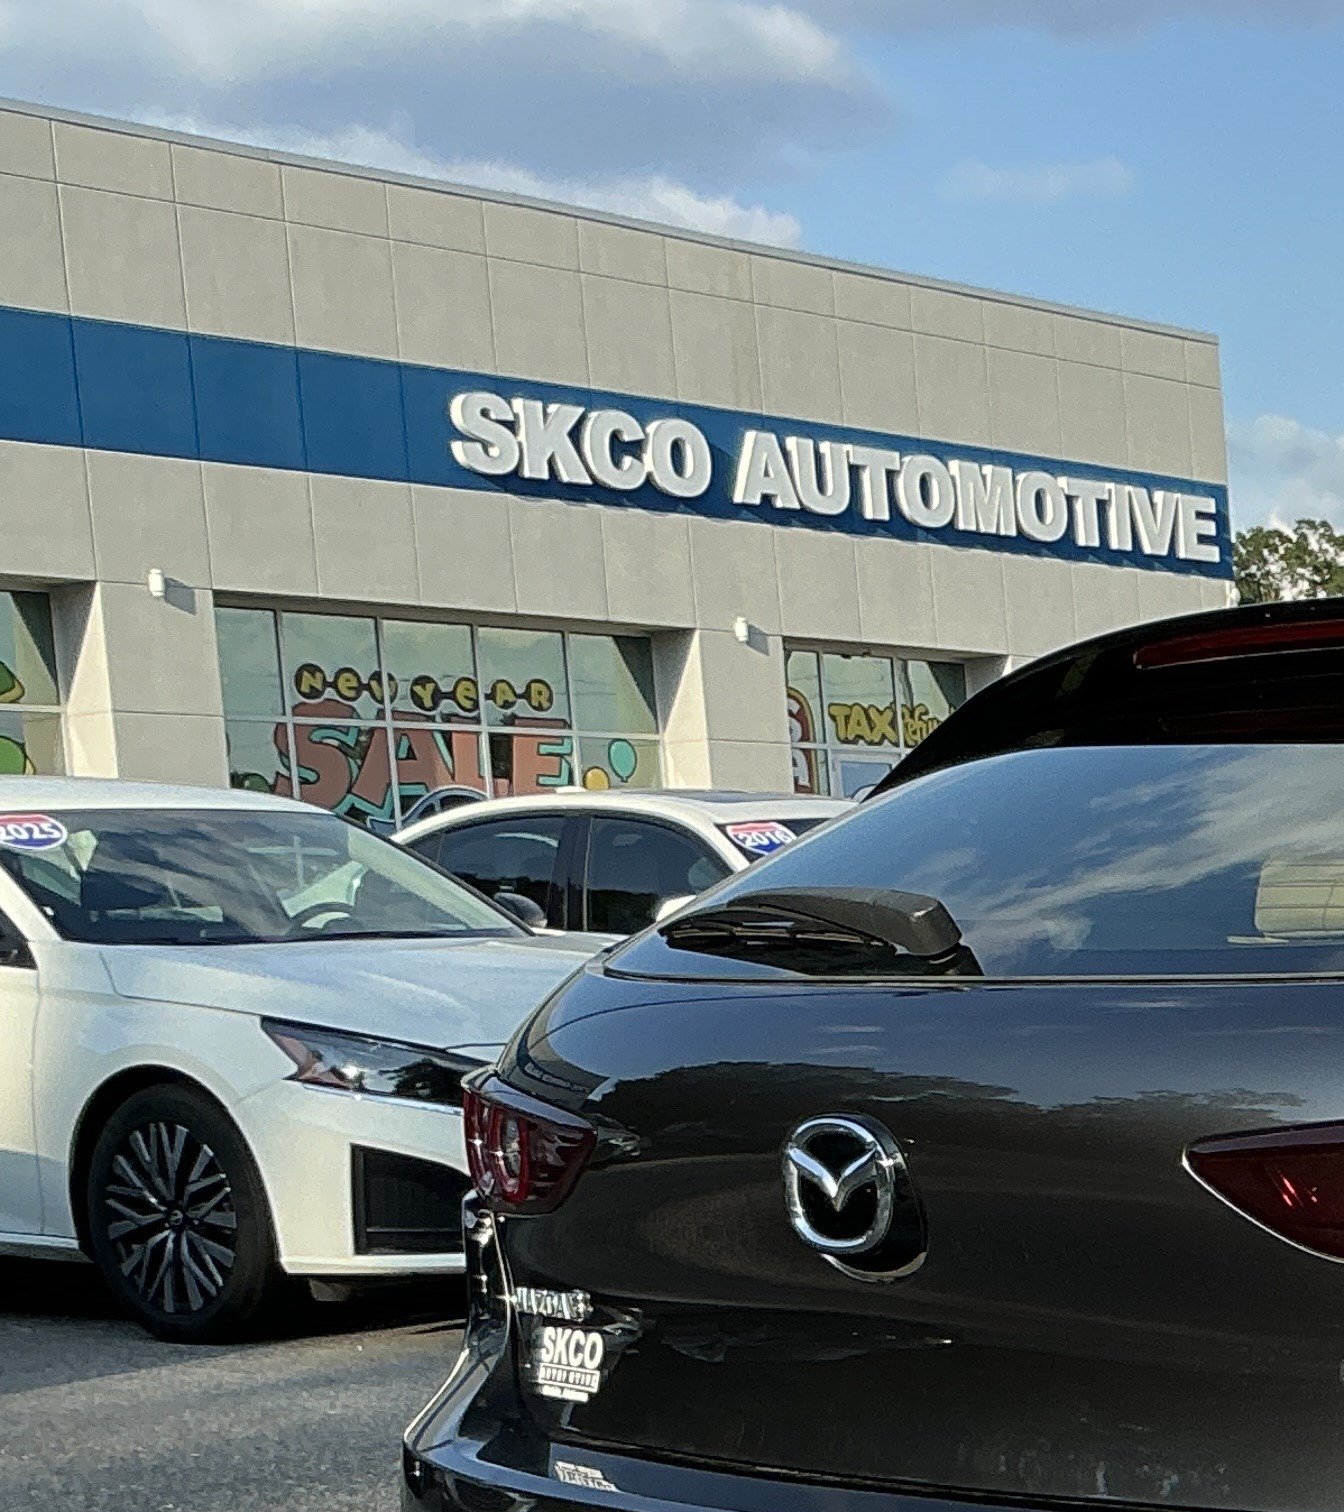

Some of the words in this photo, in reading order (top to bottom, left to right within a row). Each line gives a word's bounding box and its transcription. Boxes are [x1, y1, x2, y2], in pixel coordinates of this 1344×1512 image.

[450, 391, 712, 497] SKCO
[733, 429, 1221, 563] AUTOMOTIVE
[828, 702, 898, 747] TAX
[274, 700, 574, 812] SALE
[737, 829, 792, 847] 2016
[541, 1326, 603, 1370] SKCO
